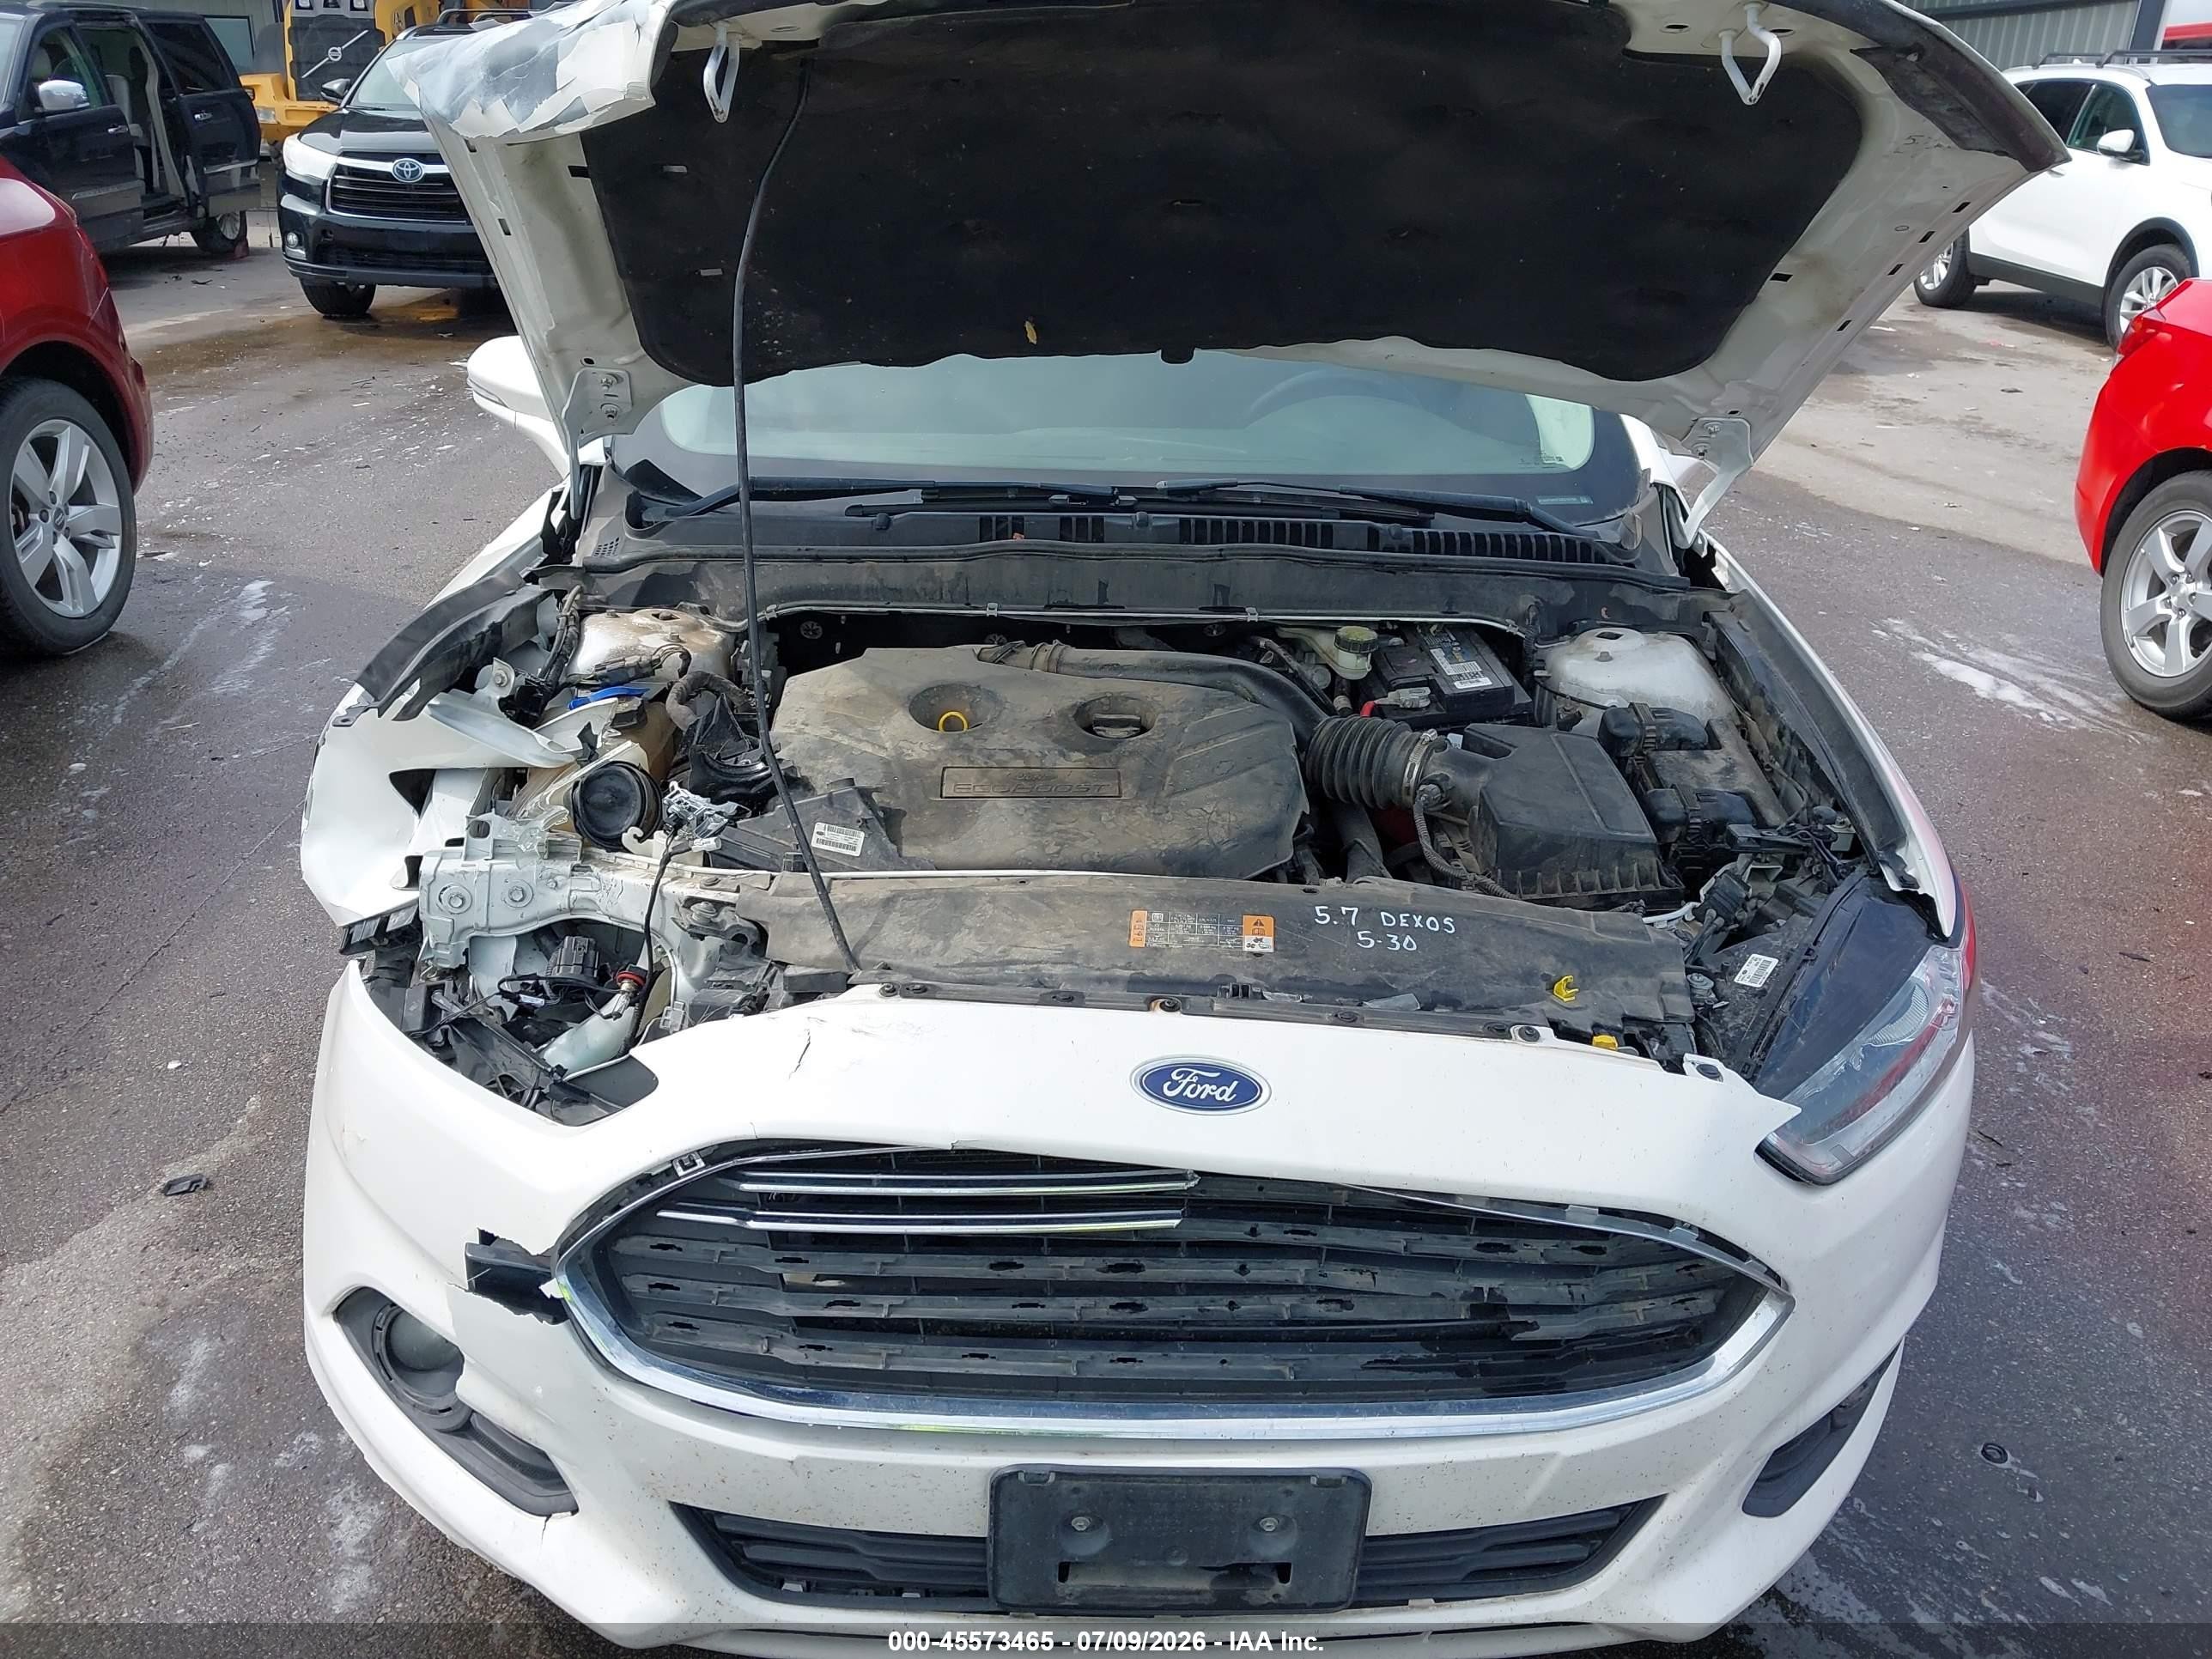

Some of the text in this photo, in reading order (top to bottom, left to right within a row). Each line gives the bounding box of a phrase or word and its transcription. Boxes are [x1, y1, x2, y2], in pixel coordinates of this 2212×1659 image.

[1314, 905, 1456, 934] 5.7 DEXOS
[1356, 931, 1418, 951] 5-30
[1163, 1067, 1239, 1102] Ford
